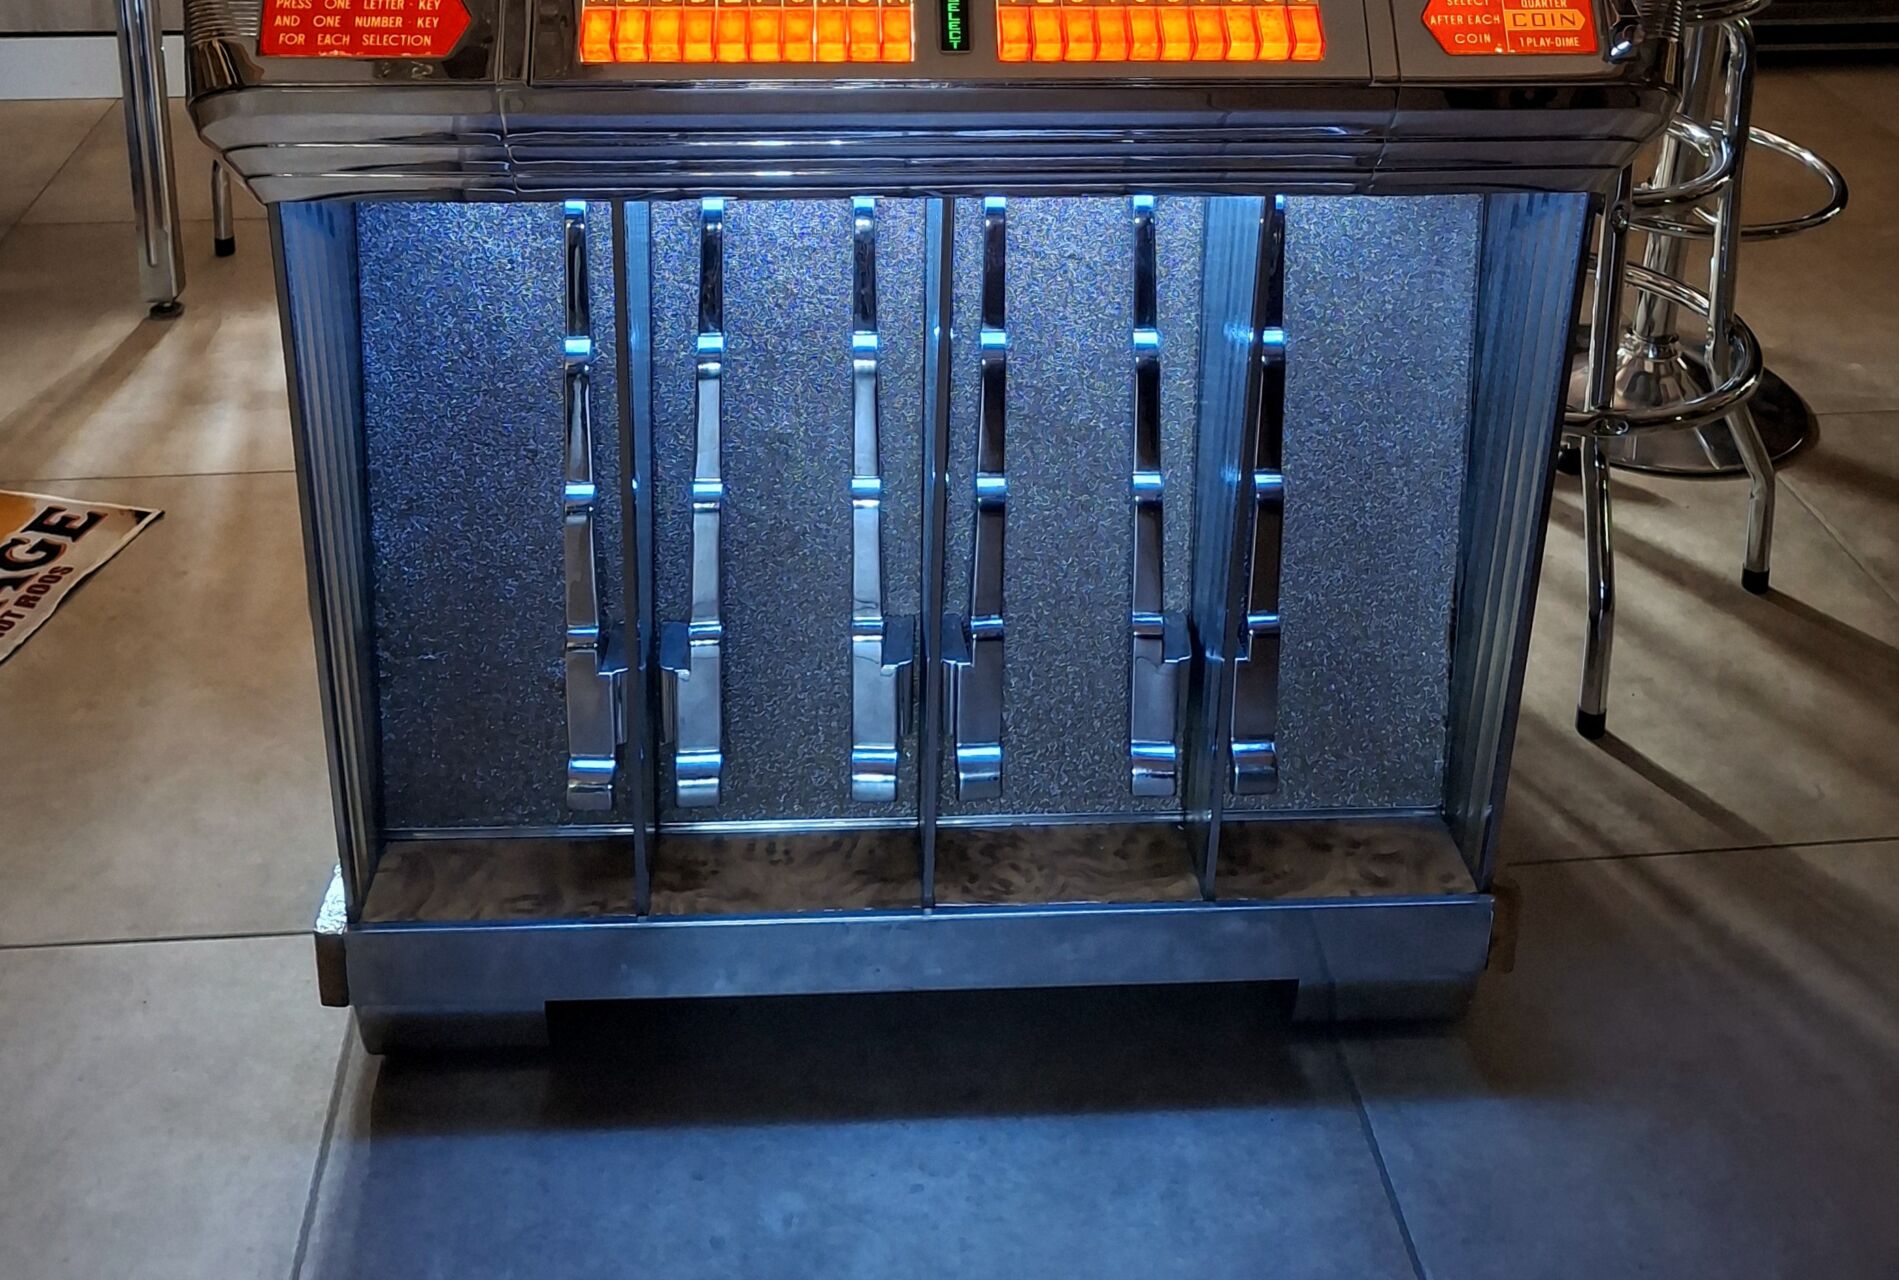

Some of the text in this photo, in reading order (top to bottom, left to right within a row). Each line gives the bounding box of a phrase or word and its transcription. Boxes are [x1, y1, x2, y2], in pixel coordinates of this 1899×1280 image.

[274, 15, 301, 27] AND
[312, 15, 341, 28] ONE
[355, 16, 403, 28] NUMBER
[1430, 14, 1500, 25] AFTER EACH
[1512, 13, 1576, 27] COIN
[278, 33, 432, 47] FOR EACH SELECTION
[1454, 33, 1491, 44] COIN
[1519, 37, 1581, 47] 1 PLAY-DIME
[0, 609, 26, 637] OT
